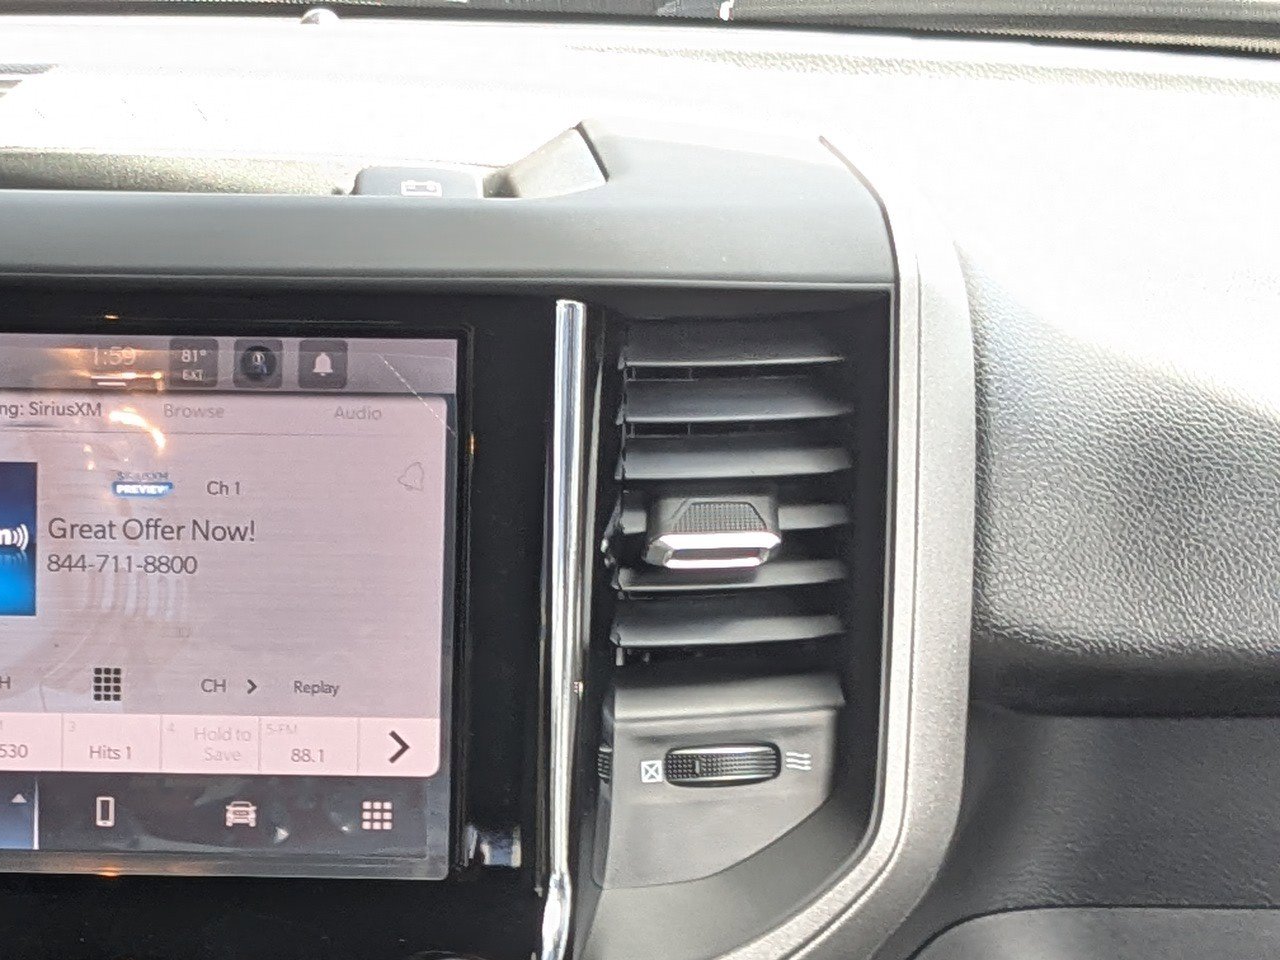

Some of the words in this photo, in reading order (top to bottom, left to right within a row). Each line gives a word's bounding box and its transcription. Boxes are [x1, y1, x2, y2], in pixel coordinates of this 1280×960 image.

[93, 346, 136, 366] 1:59
[180, 349, 207, 363] 81°
[29, 400, 102, 417] SiriusXM
[164, 404, 225, 419] Browse
[334, 405, 382, 421] Audio
[206, 480, 229, 496] Ch
[234, 481, 240, 495] 1
[48, 518, 116, 540] Great
[122, 517, 185, 541] Offer
[191, 519, 255, 542] Now!
[46, 553, 198, 575] 844-711-8800
[200, 678, 226, 693] CH
[293, 680, 339, 697] Replay
[193, 726, 232, 742] Hold
[235, 727, 252, 742] to
[89, 745, 121, 760] Hits
[126, 746, 132, 760] 1
[204, 747, 241, 762] Save
[290, 748, 325, 763] 88.1
